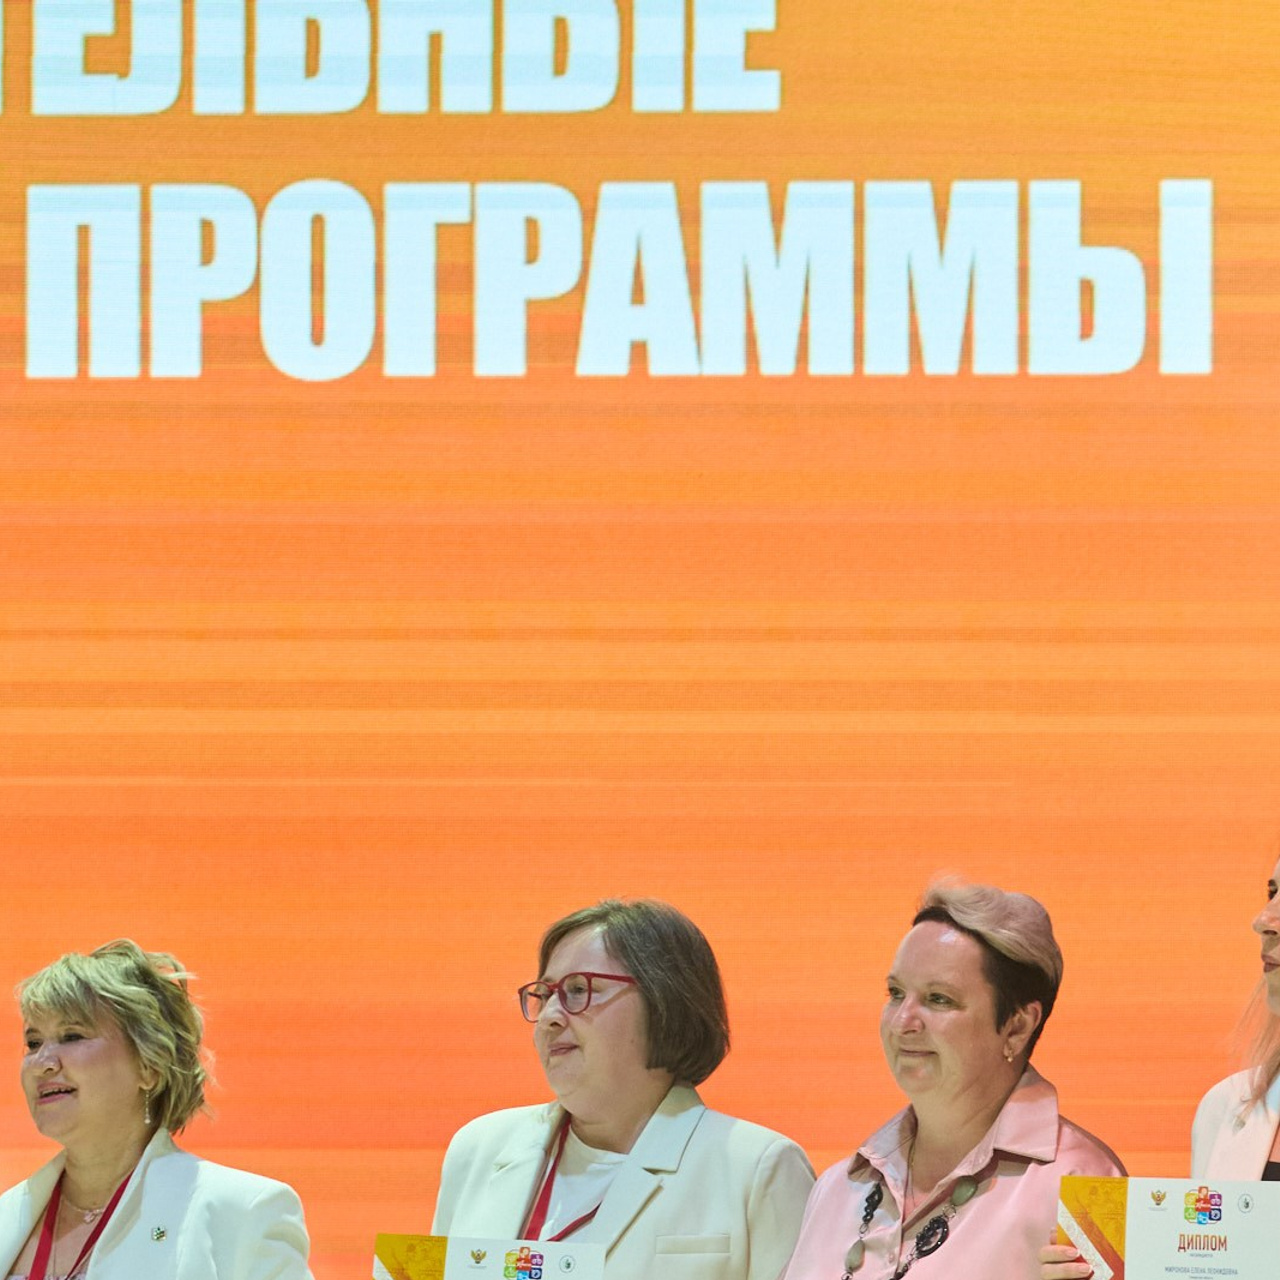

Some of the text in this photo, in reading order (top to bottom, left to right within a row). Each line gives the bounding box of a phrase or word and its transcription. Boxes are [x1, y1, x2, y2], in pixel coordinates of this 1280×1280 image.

[0, 0, 781, 116] ЕЛЬНЫЕ
[25, 178, 1214, 382] ПРОГРАММЫ
[1177, 1233, 1228, 1253] ДИПЛОМ
